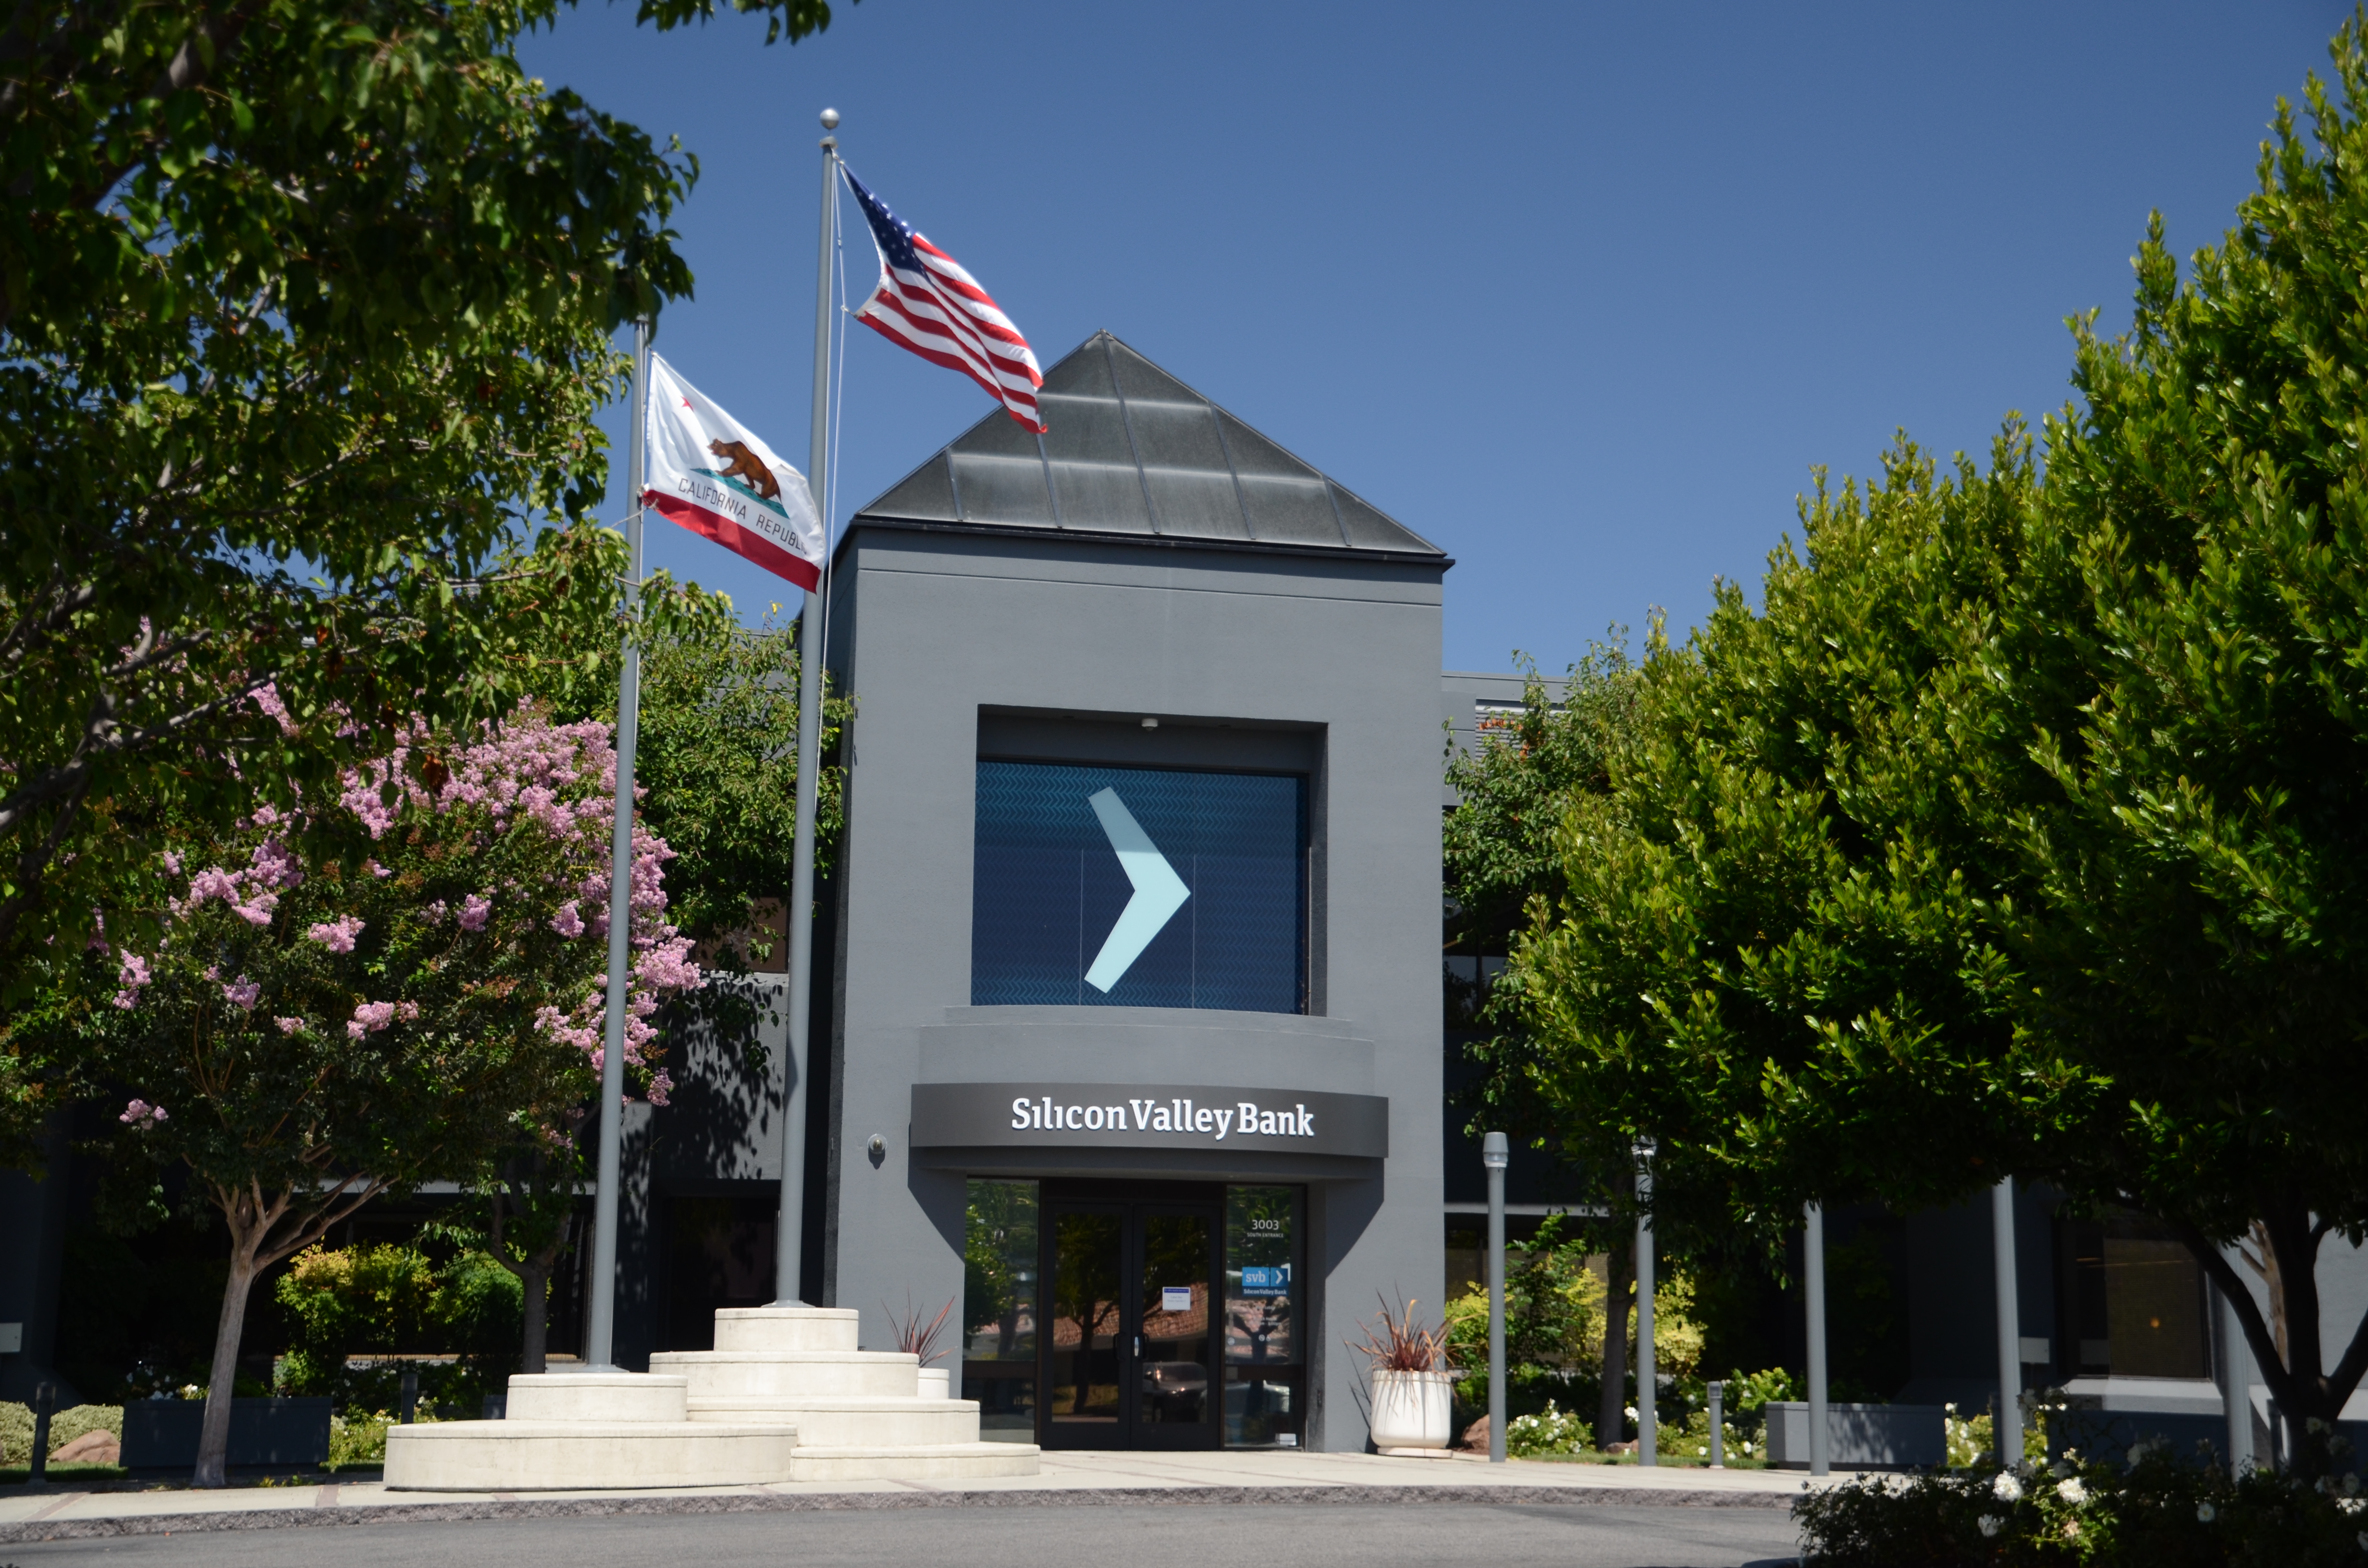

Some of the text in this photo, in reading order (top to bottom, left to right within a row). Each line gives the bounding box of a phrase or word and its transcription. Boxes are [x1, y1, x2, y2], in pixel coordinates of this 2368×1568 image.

[678, 478, 746, 519] CALIFORNIA
[1011, 1097, 1314, 1141] Silicon Valley Bank
[1252, 1219, 1279, 1230] 3003
[1246, 1270, 1266, 1283] svb
